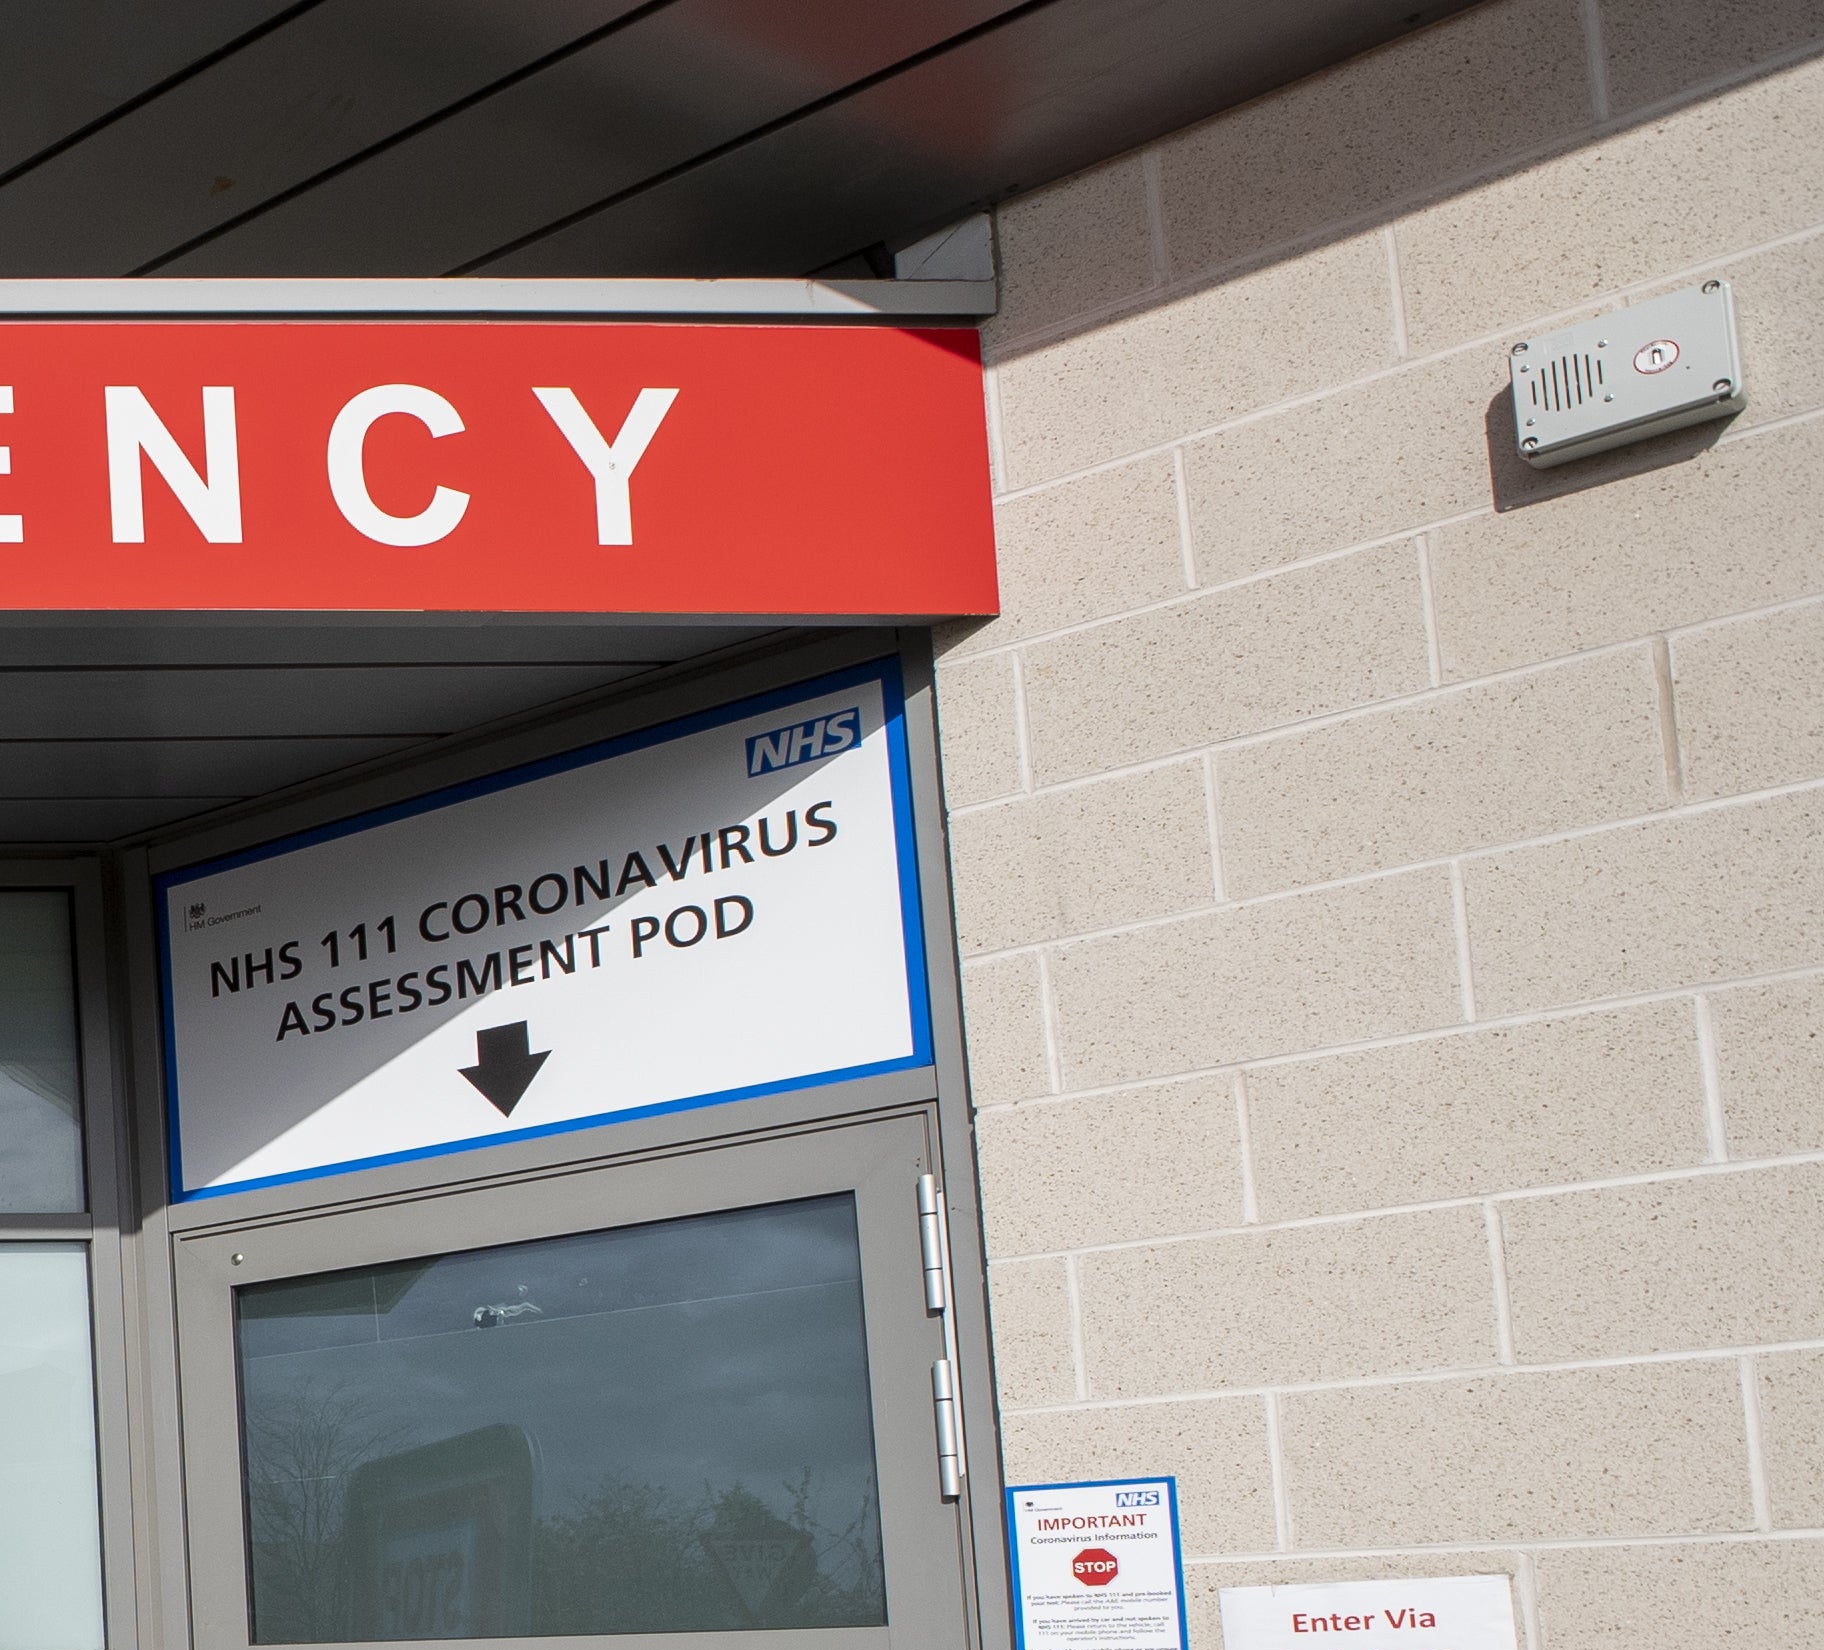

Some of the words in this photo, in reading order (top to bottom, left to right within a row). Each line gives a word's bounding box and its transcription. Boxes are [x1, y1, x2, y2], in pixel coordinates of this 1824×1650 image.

[749, 708, 859, 776] NHS
[210, 937, 302, 999] NHS
[321, 915, 399, 969] 111
[419, 800, 839, 943] CORONAVIRUS
[189, 920, 206, 931] HM
[207, 905, 262, 927] Government
[276, 925, 611, 1042] ASSESSMENT
[631, 894, 755, 959] POD
[1116, 1491, 1159, 1507] NHS
[1037, 1513, 1147, 1532] IMPORTANT
[1030, 1534, 1092, 1545] Coronavirus
[1094, 1531, 1158, 1542] Information
[1074, 1560, 1117, 1574] STOP
[1292, 1612, 1375, 1633] Enter
[1384, 1607, 1436, 1629] Via
